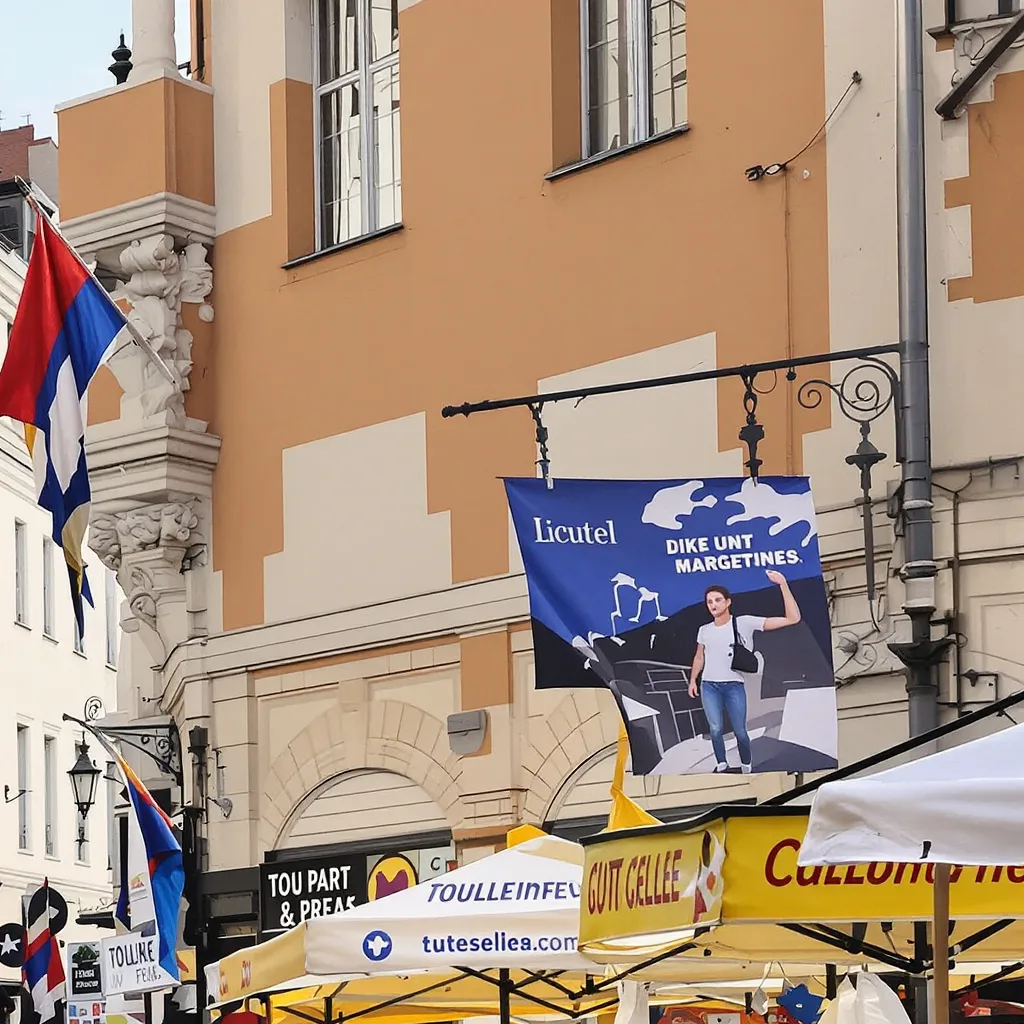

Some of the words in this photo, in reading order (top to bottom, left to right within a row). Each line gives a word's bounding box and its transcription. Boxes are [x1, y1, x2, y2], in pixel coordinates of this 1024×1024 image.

[533, 516, 617, 544] Licutel
[666, 537, 709, 554] DIKE
[713, 534, 753, 550] UNT
[268, 870, 302, 897] TOU
[307, 865, 351, 893] PART
[280, 901, 295, 927] &
